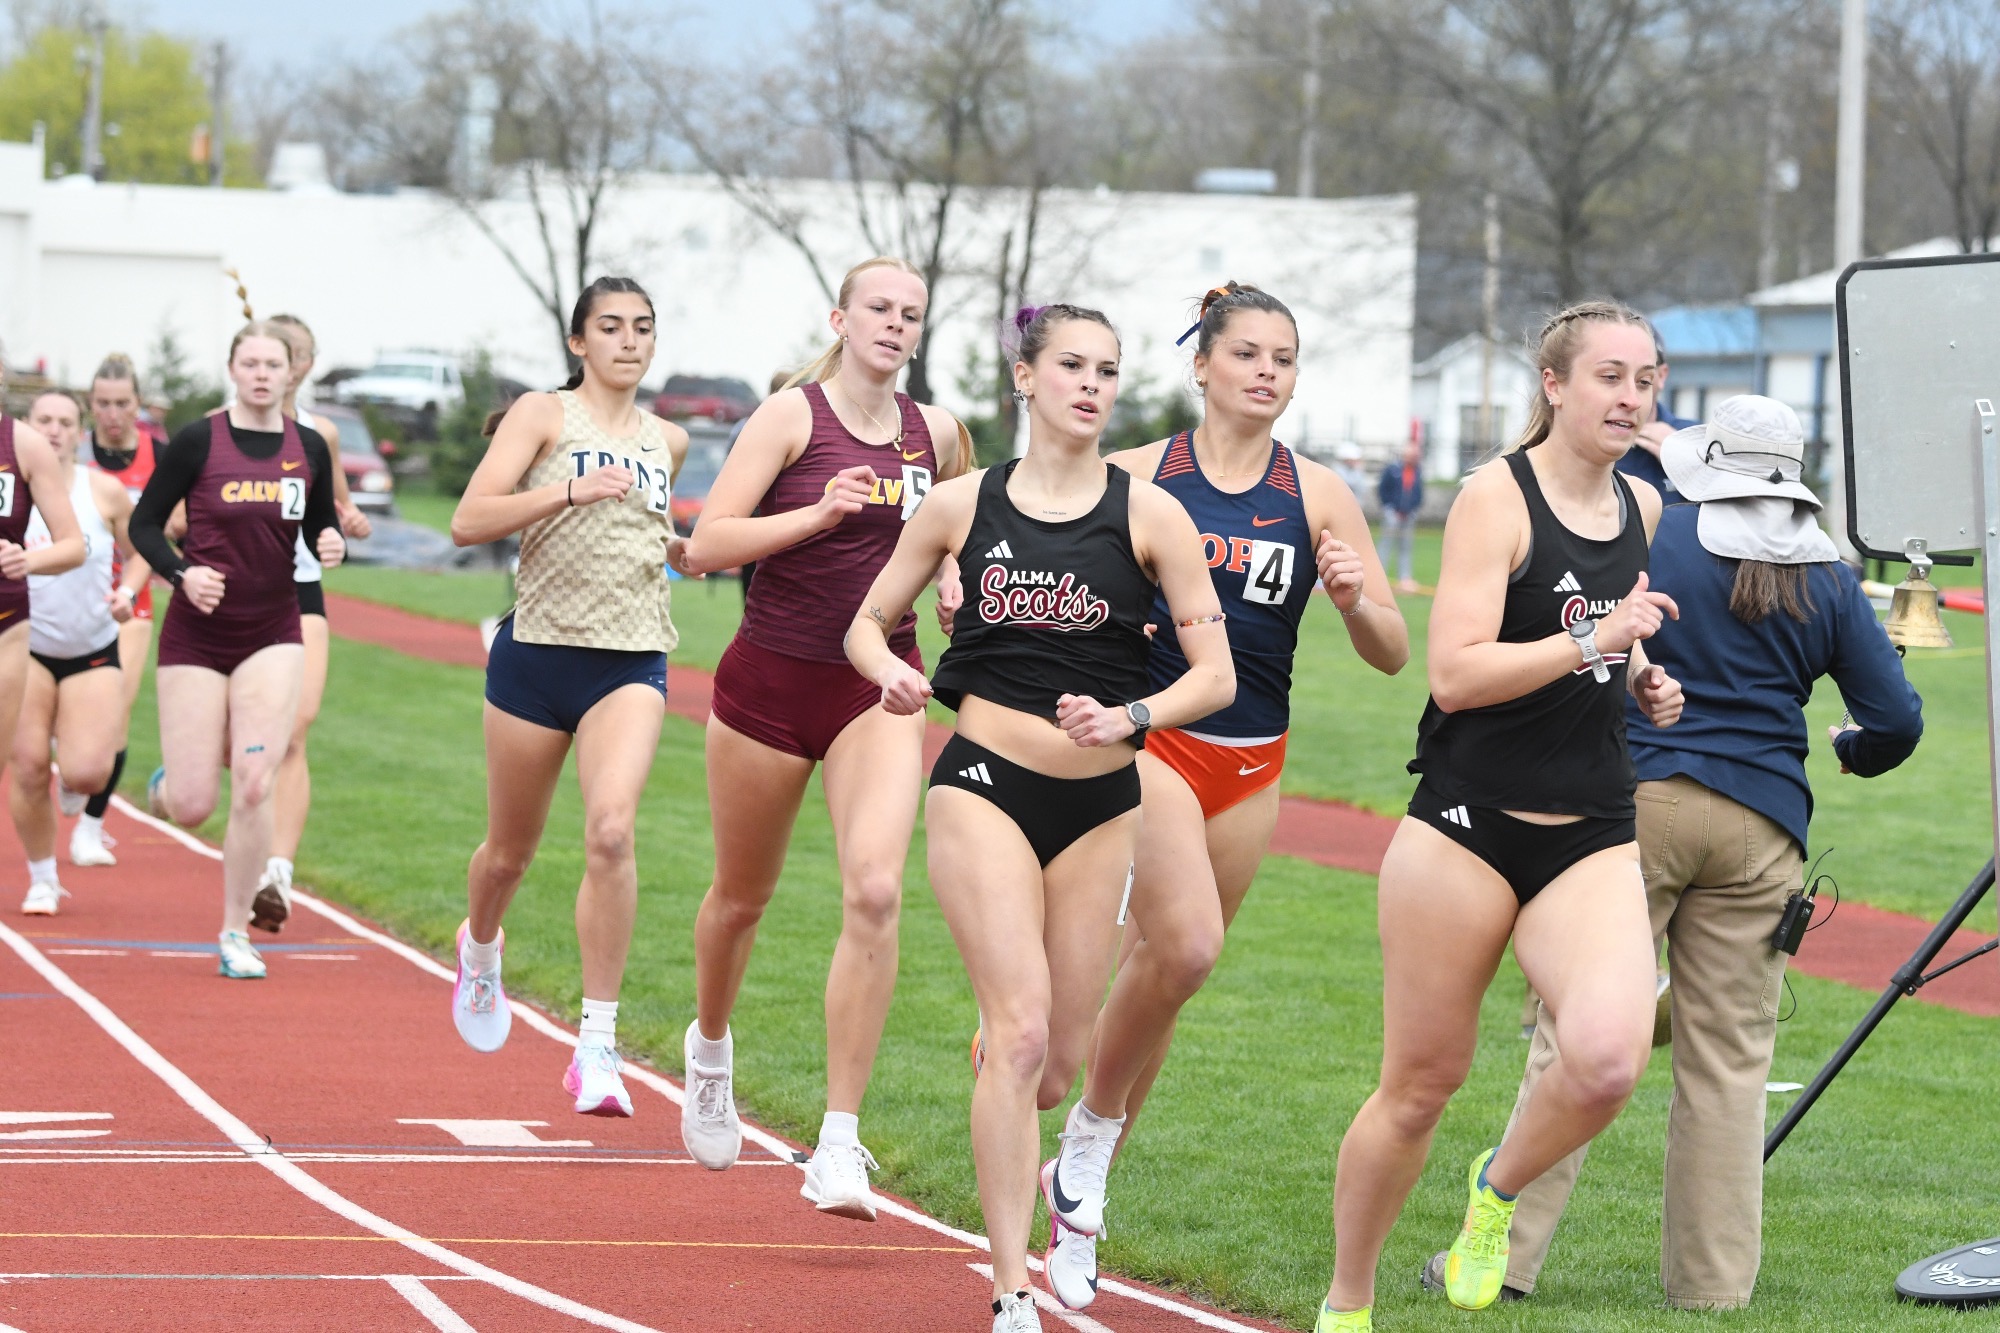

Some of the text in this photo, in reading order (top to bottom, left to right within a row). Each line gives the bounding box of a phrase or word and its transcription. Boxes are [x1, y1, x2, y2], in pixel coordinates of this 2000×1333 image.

[288, 482, 299, 515] 2
[654, 468, 667, 511] 3
[1008, 570, 1057, 586] ALMA
[1254, 547, 1285, 601] 4
[979, 564, 1109, 628] Scots
